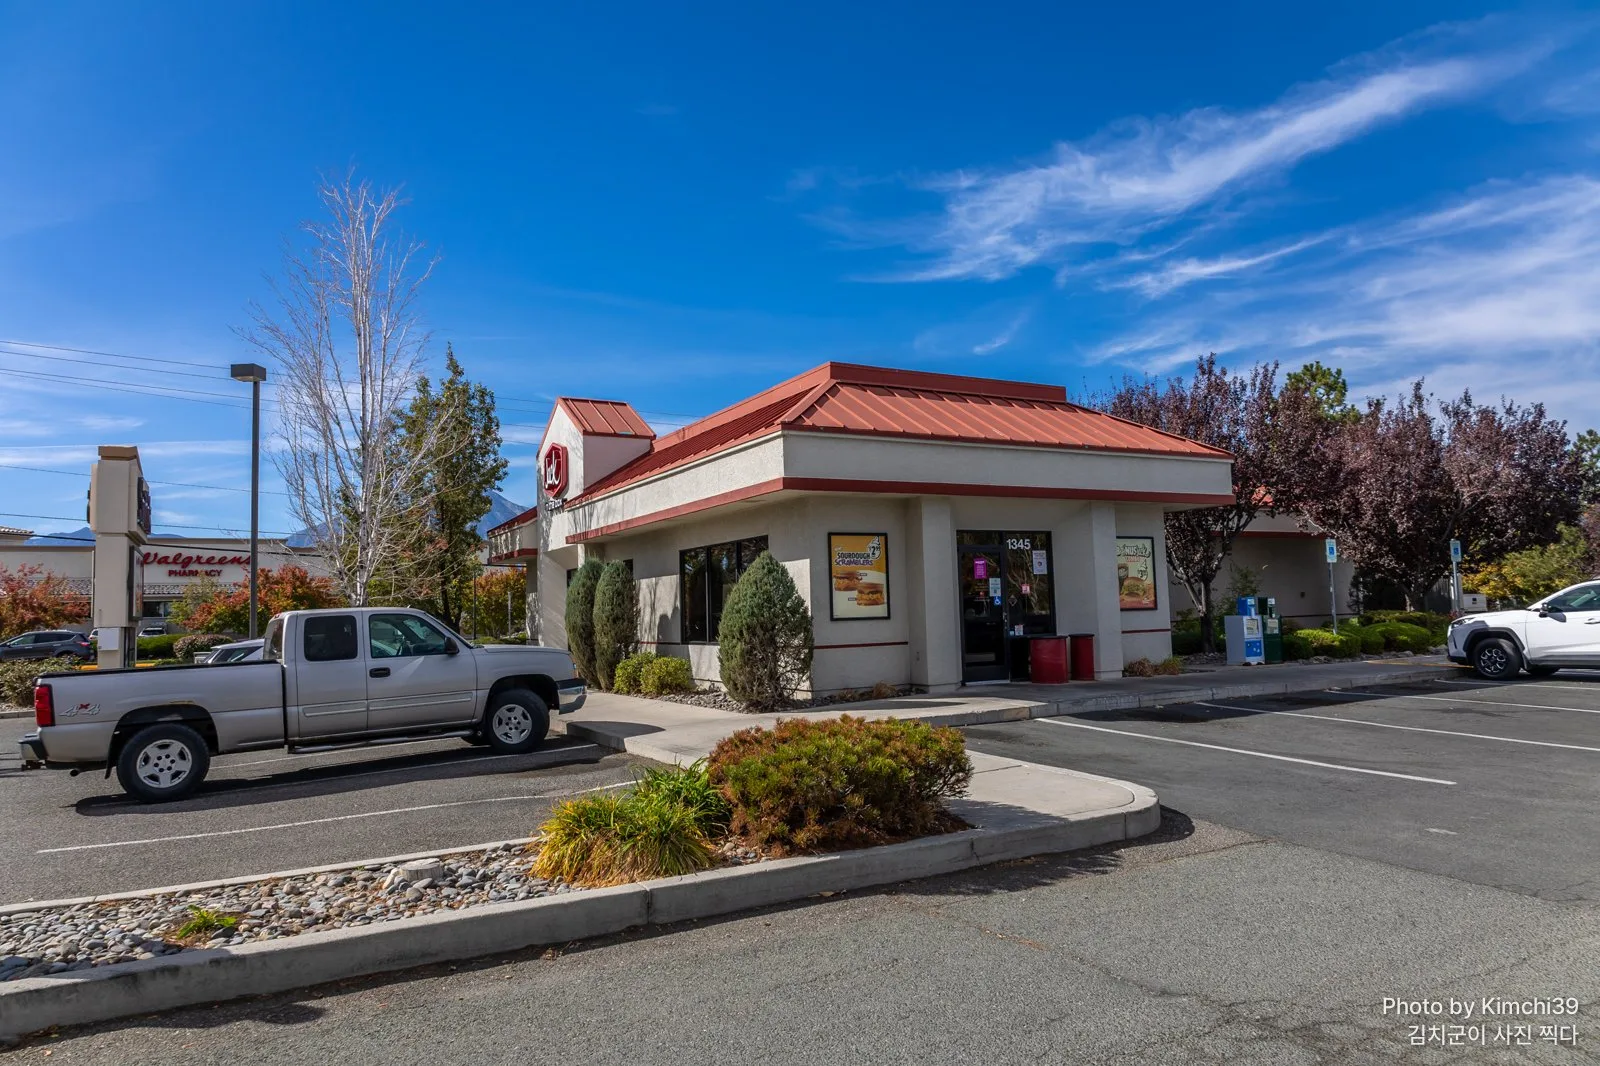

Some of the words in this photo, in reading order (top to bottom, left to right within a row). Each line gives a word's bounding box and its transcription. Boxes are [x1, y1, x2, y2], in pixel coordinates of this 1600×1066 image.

[545, 450, 561, 489] Jack
[1006, 538, 1031, 550] 1345
[837, 552, 871, 560] SOURDOUGH
[835, 558, 873, 566] SCRAMBLERS
